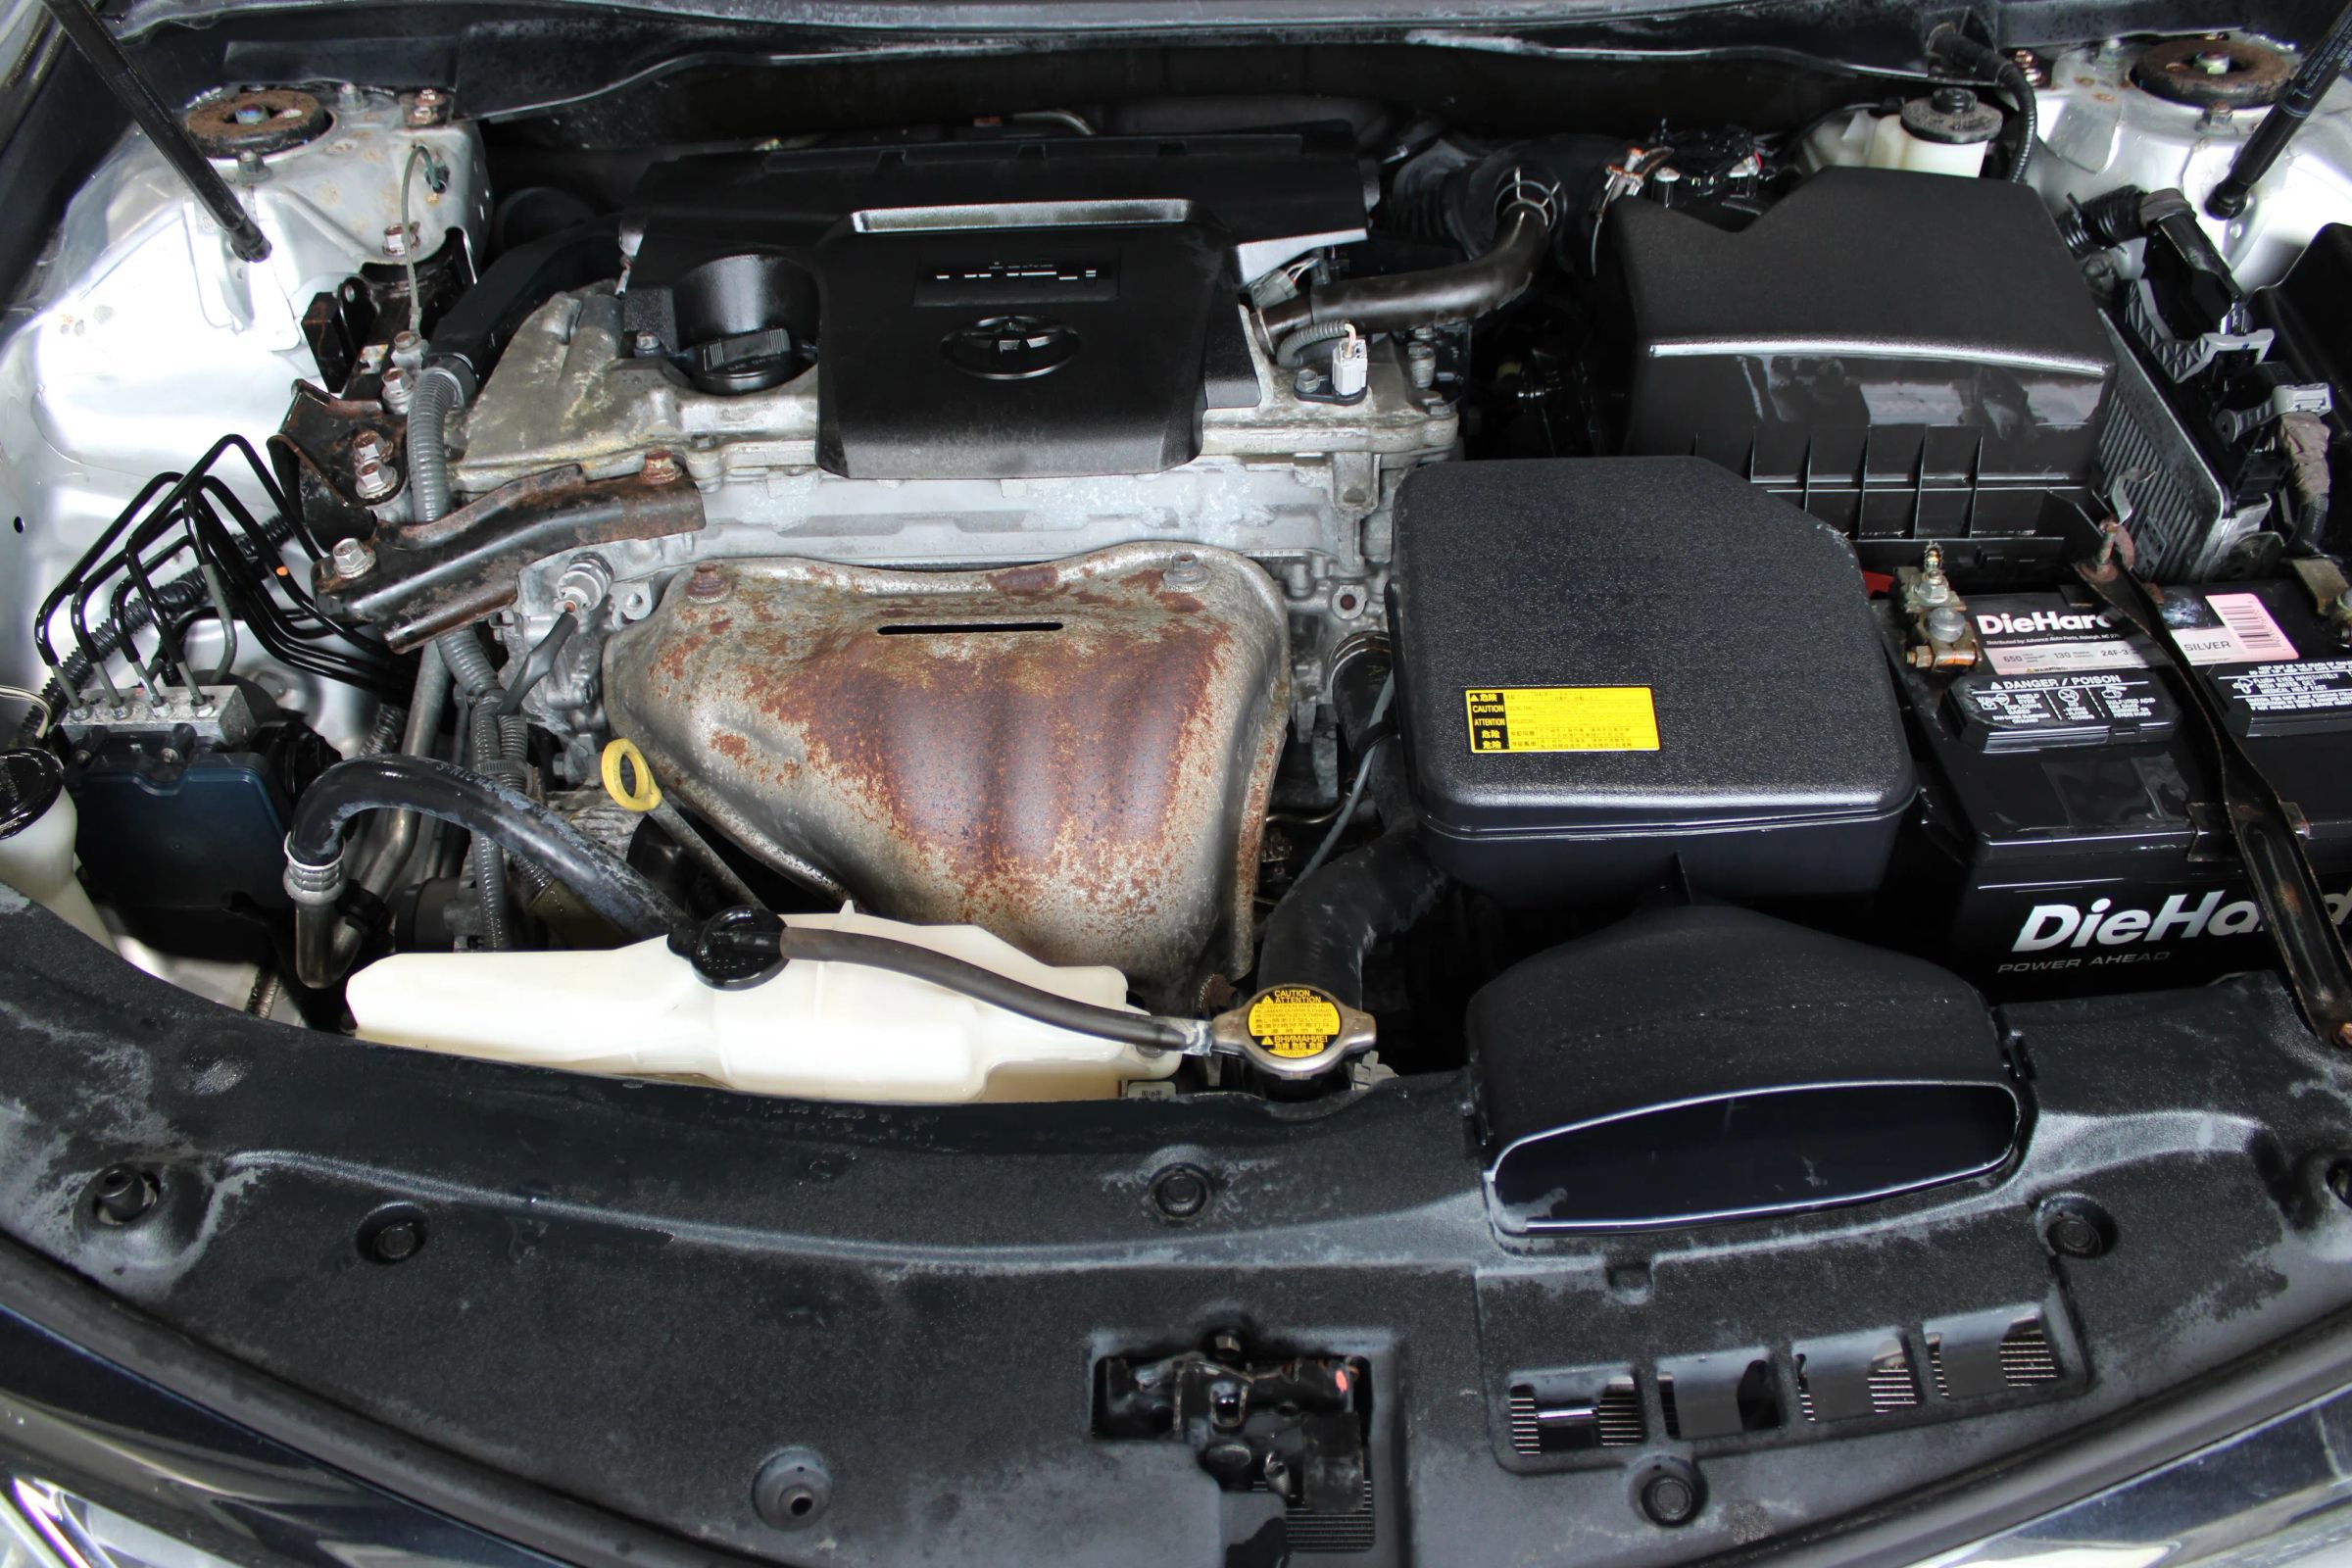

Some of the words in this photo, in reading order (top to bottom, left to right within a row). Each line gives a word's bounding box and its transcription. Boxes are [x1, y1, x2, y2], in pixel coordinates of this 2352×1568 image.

[2183, 640, 2231, 652] SILVER
[2002, 678, 2060, 689] DANGER
[2061, 677, 2069, 686] /
[2071, 674, 2122, 686] POISON
[1472, 705, 1505, 713] CAUTION
[1474, 717, 1506, 726] ATTENTION
[1997, 957, 2082, 973] POWER
[2087, 951, 2172, 966] AHEAD
[1274, 989, 1311, 998] CAUTION
[1274, 1034, 1328, 1044] ВНИМАНИЕ!
